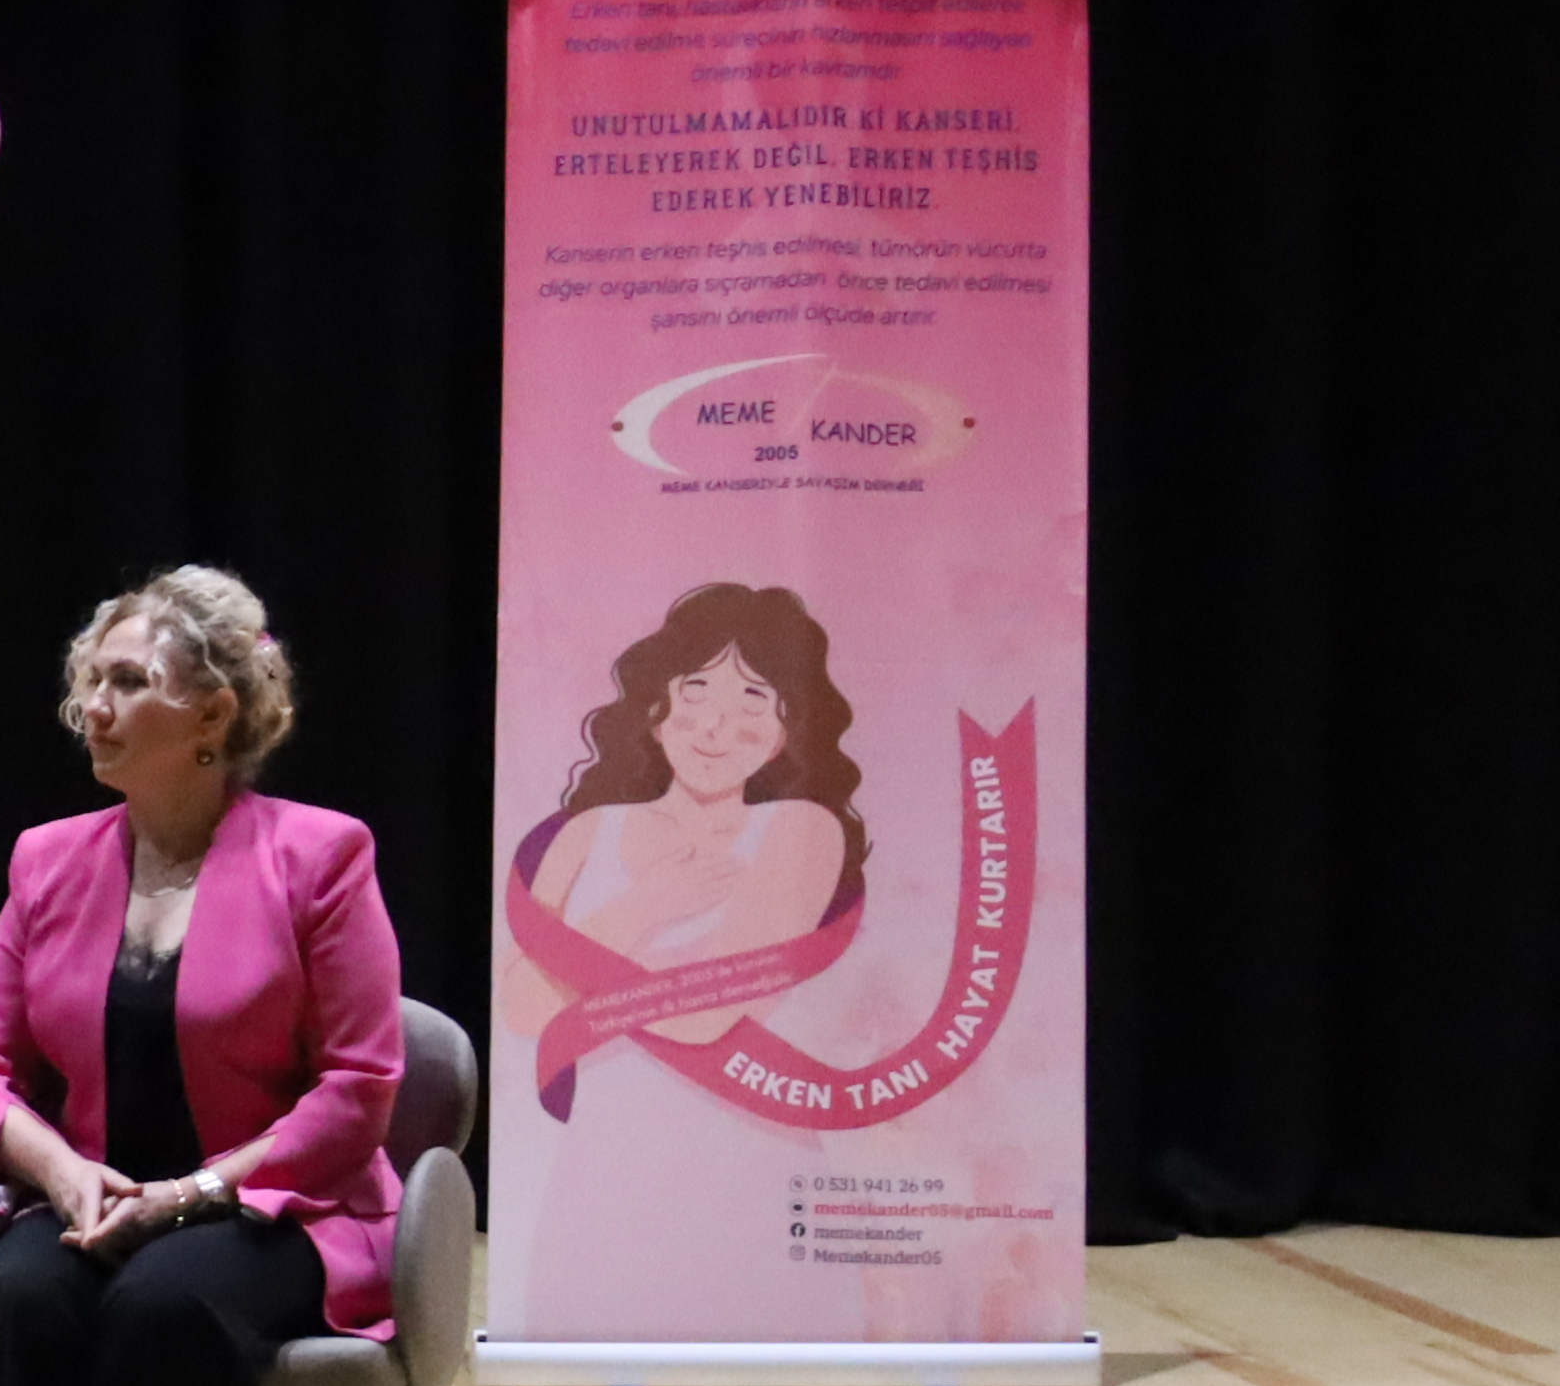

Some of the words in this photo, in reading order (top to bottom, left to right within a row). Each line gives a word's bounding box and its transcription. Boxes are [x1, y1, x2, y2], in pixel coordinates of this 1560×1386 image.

[571, 105, 847, 138] UNUTULMAMALIDIR
[859, 106, 884, 131] Kİ
[554, 148, 741, 177] ERTELEYEREK
[848, 146, 934, 170] ERKEN
[945, 145, 1039, 174] TEŞHİS
[651, 187, 753, 213] EDEREK
[545, 244, 635, 264] Kanserin
[640, 243, 701, 261] erken
[707, 239, 767, 261] teşhis
[538, 281, 593, 302] diğer
[599, 277, 699, 300] organlara
[837, 270, 889, 291] önce
[726, 305, 799, 326] önemli
[697, 400, 776, 425] MEME
[811, 419, 916, 446] KANDER
[754, 445, 799, 462] 2005
[661, 480, 699, 493] MEME
[723, 1050, 832, 1110] ERKEN
[844, 1059, 930, 1111] TANI
[936, 944, 1001, 1060] HAYAT
[970, 755, 1008, 929] KURTARIR
[814, 1178, 824, 1192] 0
[828, 1178, 858, 1192] 531
[863, 1179, 892, 1193] 941
[899, 1179, 919, 1193] 26
[923, 1179, 944, 1193] 99
[814, 1226, 923, 1241] memekander
